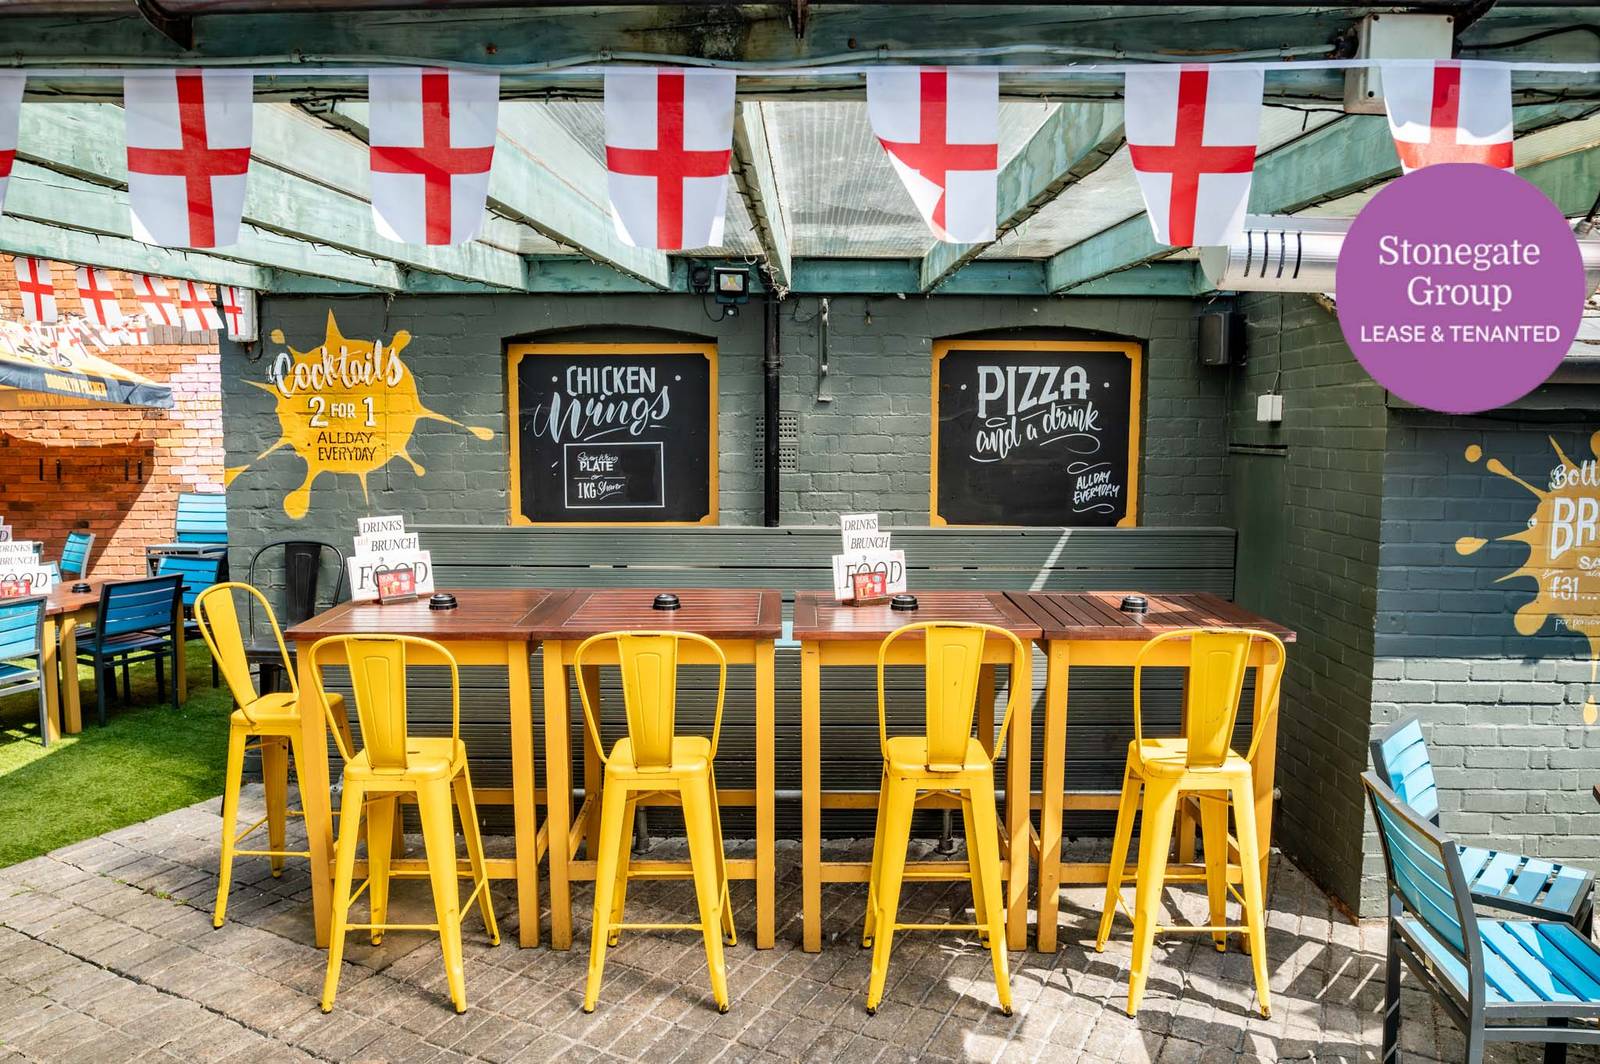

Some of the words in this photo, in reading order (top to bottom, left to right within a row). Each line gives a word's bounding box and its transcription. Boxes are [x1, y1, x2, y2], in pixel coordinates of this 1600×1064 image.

[266, 339, 403, 398] Cocktails
[566, 365, 656, 396] CHICKEN
[976, 365, 1091, 418] PIZZA
[308, 396, 329, 427] 2
[330, 401, 357, 418] FOR
[362, 396, 377, 427] 1
[533, 385, 671, 443] Wings
[975, 416, 1022, 459] and
[1026, 423, 1038, 440] a
[1042, 401, 1103, 434] drink
[318, 446, 377, 461] EVERYDAY
[579, 459, 614, 472] PLATE
[577, 482, 598, 499] 1KG
[1072, 484, 1121, 505] EVERYDAY
[362, 519, 403, 534] DRINKS
[844, 518, 877, 531] DRINKS
[371, 537, 417, 552] BRUNCH
[850, 536, 889, 549] BRUNCH
